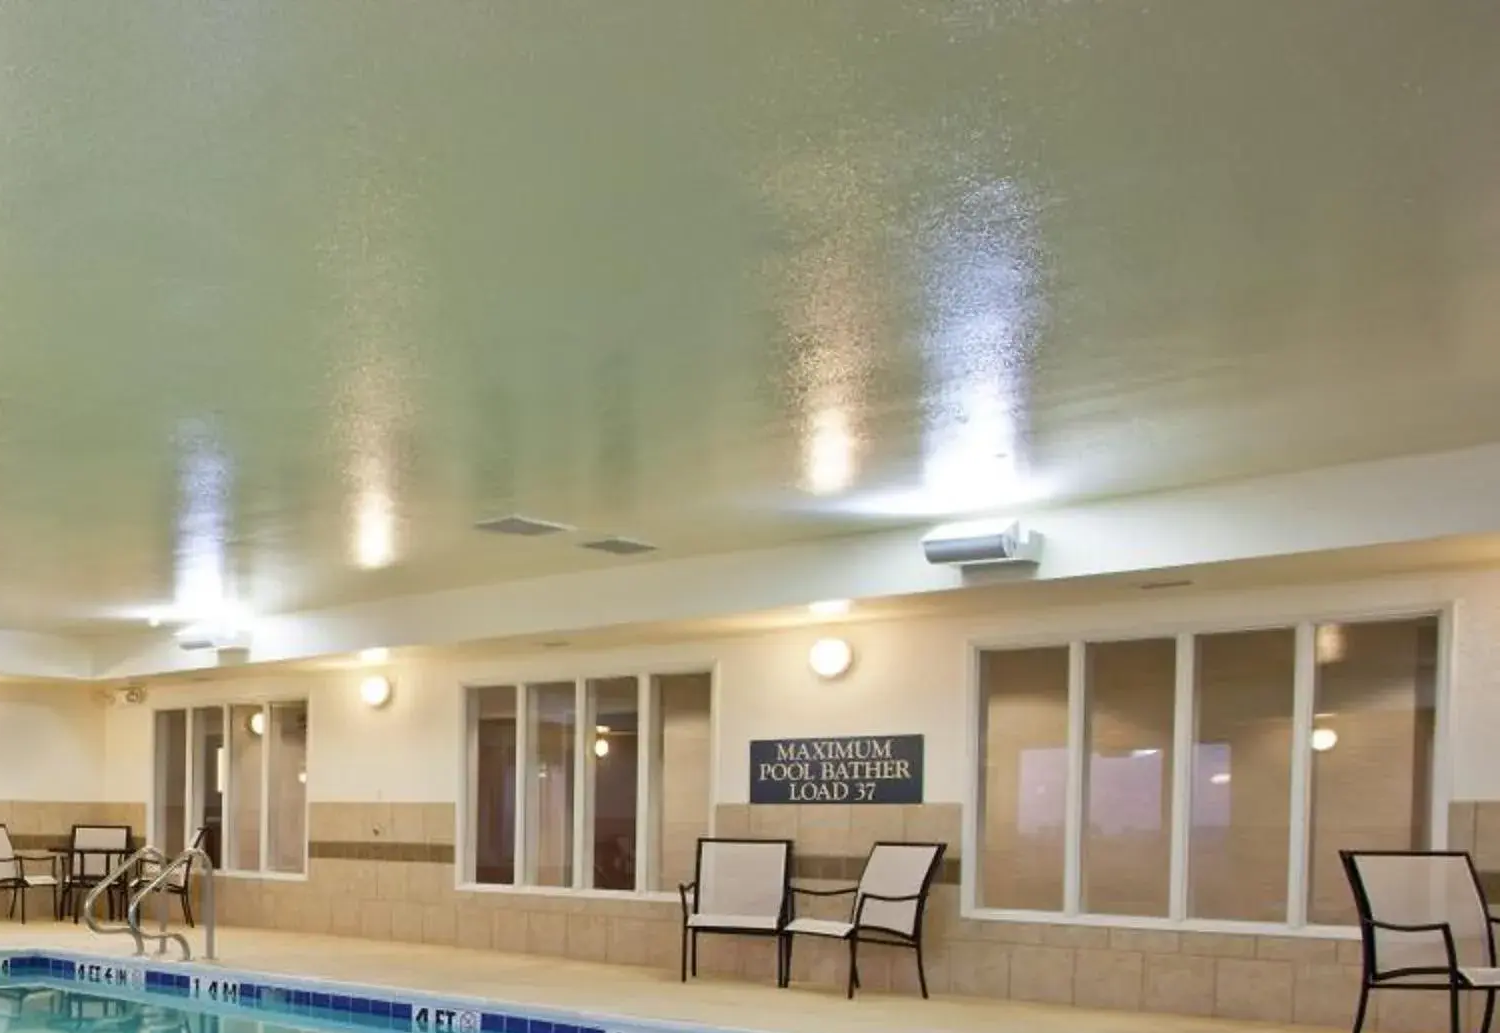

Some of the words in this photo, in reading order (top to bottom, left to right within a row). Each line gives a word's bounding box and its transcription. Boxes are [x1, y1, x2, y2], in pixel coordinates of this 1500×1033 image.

[777, 740, 893, 761] MAXIMUM
[759, 763, 816, 781] POOL
[821, 760, 912, 780] BATHER
[789, 783, 849, 800] LOAD
[855, 782, 877, 800] 37
